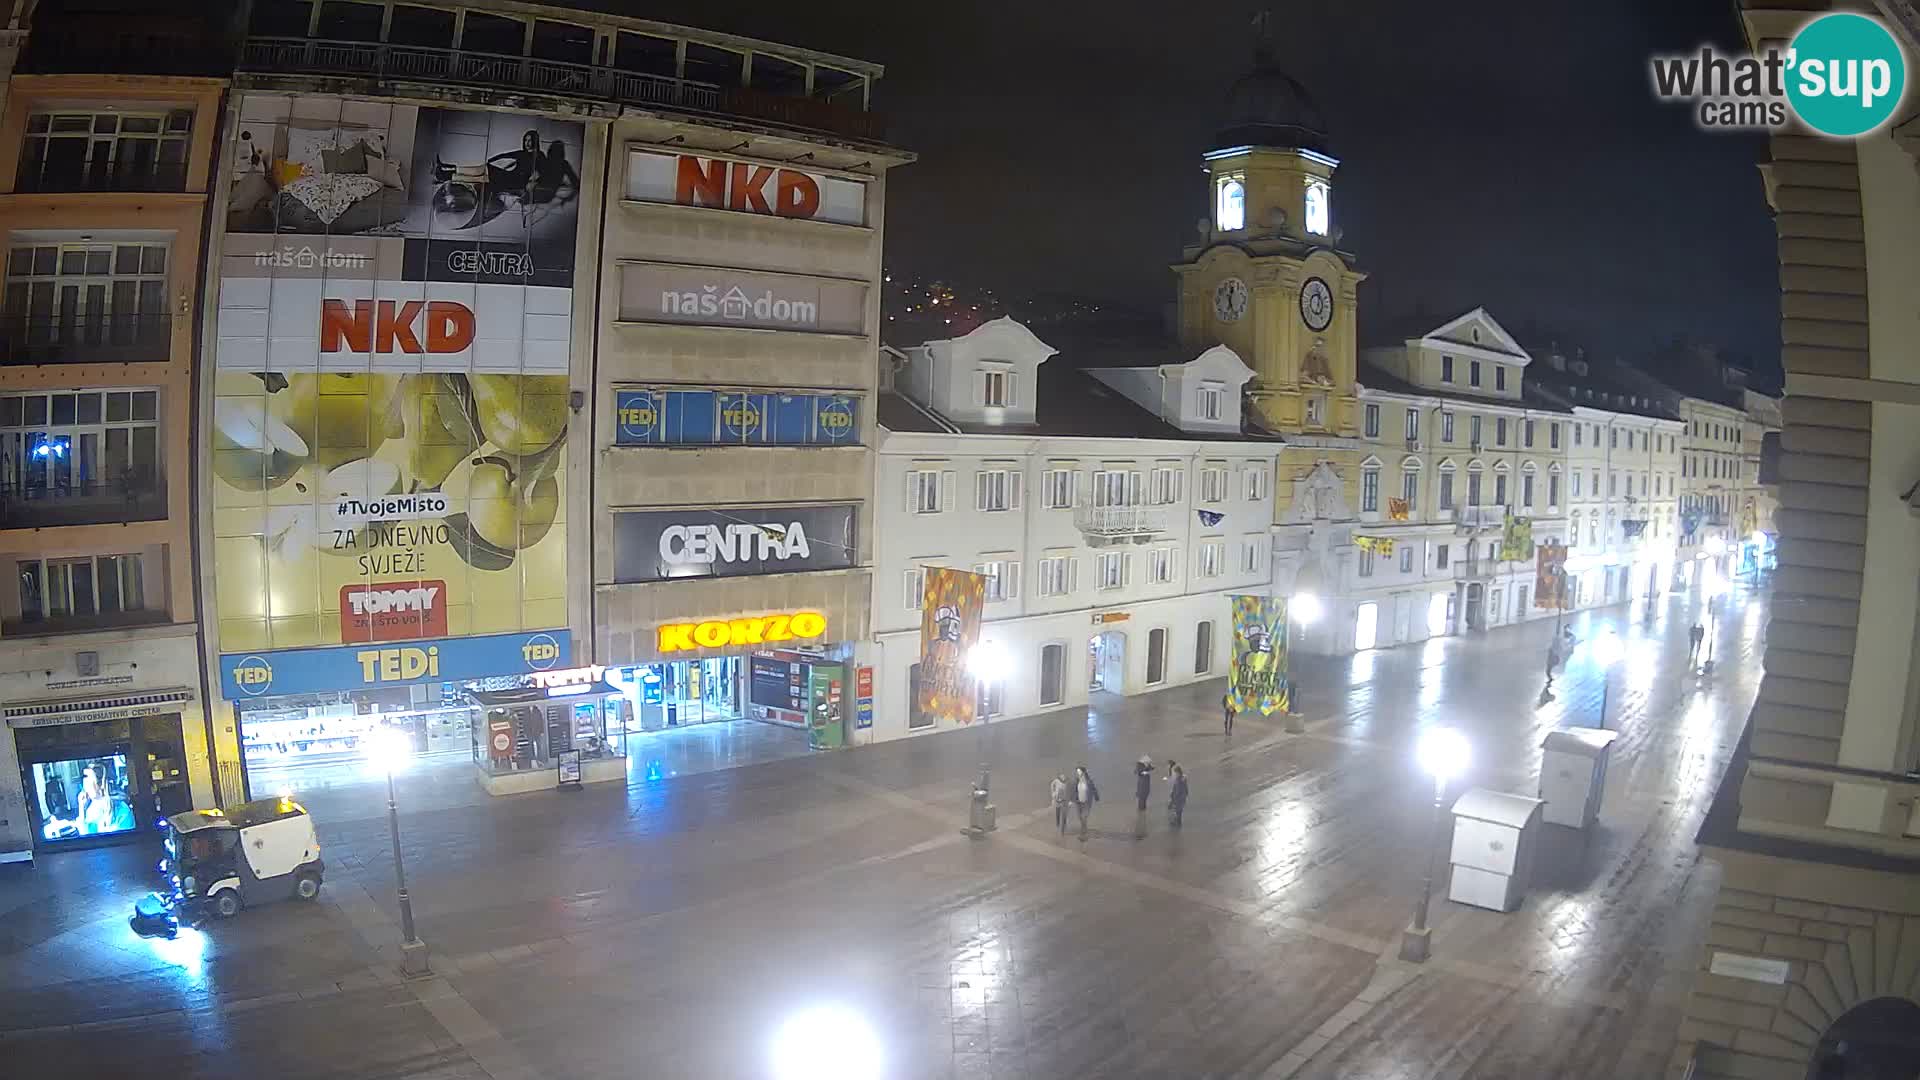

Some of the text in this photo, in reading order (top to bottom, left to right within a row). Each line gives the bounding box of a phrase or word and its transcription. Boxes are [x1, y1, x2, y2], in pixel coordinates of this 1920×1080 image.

[675, 154, 820, 218] NKD
[255, 246, 366, 270] naš dom
[448, 250, 534, 276] CENTRA
[661, 284, 816, 322] naš dom
[320, 298, 476, 354] NKD
[619, 408, 657, 425] TEDi
[337, 497, 446, 517] #TvojeMisto
[333, 524, 450, 549] ZA DNEVNO
[659, 521, 809, 563] CENTRA
[359, 548, 426, 576] SVJEŽE
[348, 586, 438, 615] TOMMY
[658, 611, 826, 653] KORZO
[357, 646, 439, 683] TEDi
[522, 641, 559, 662] TEDi
[233, 666, 272, 686] TEDi
